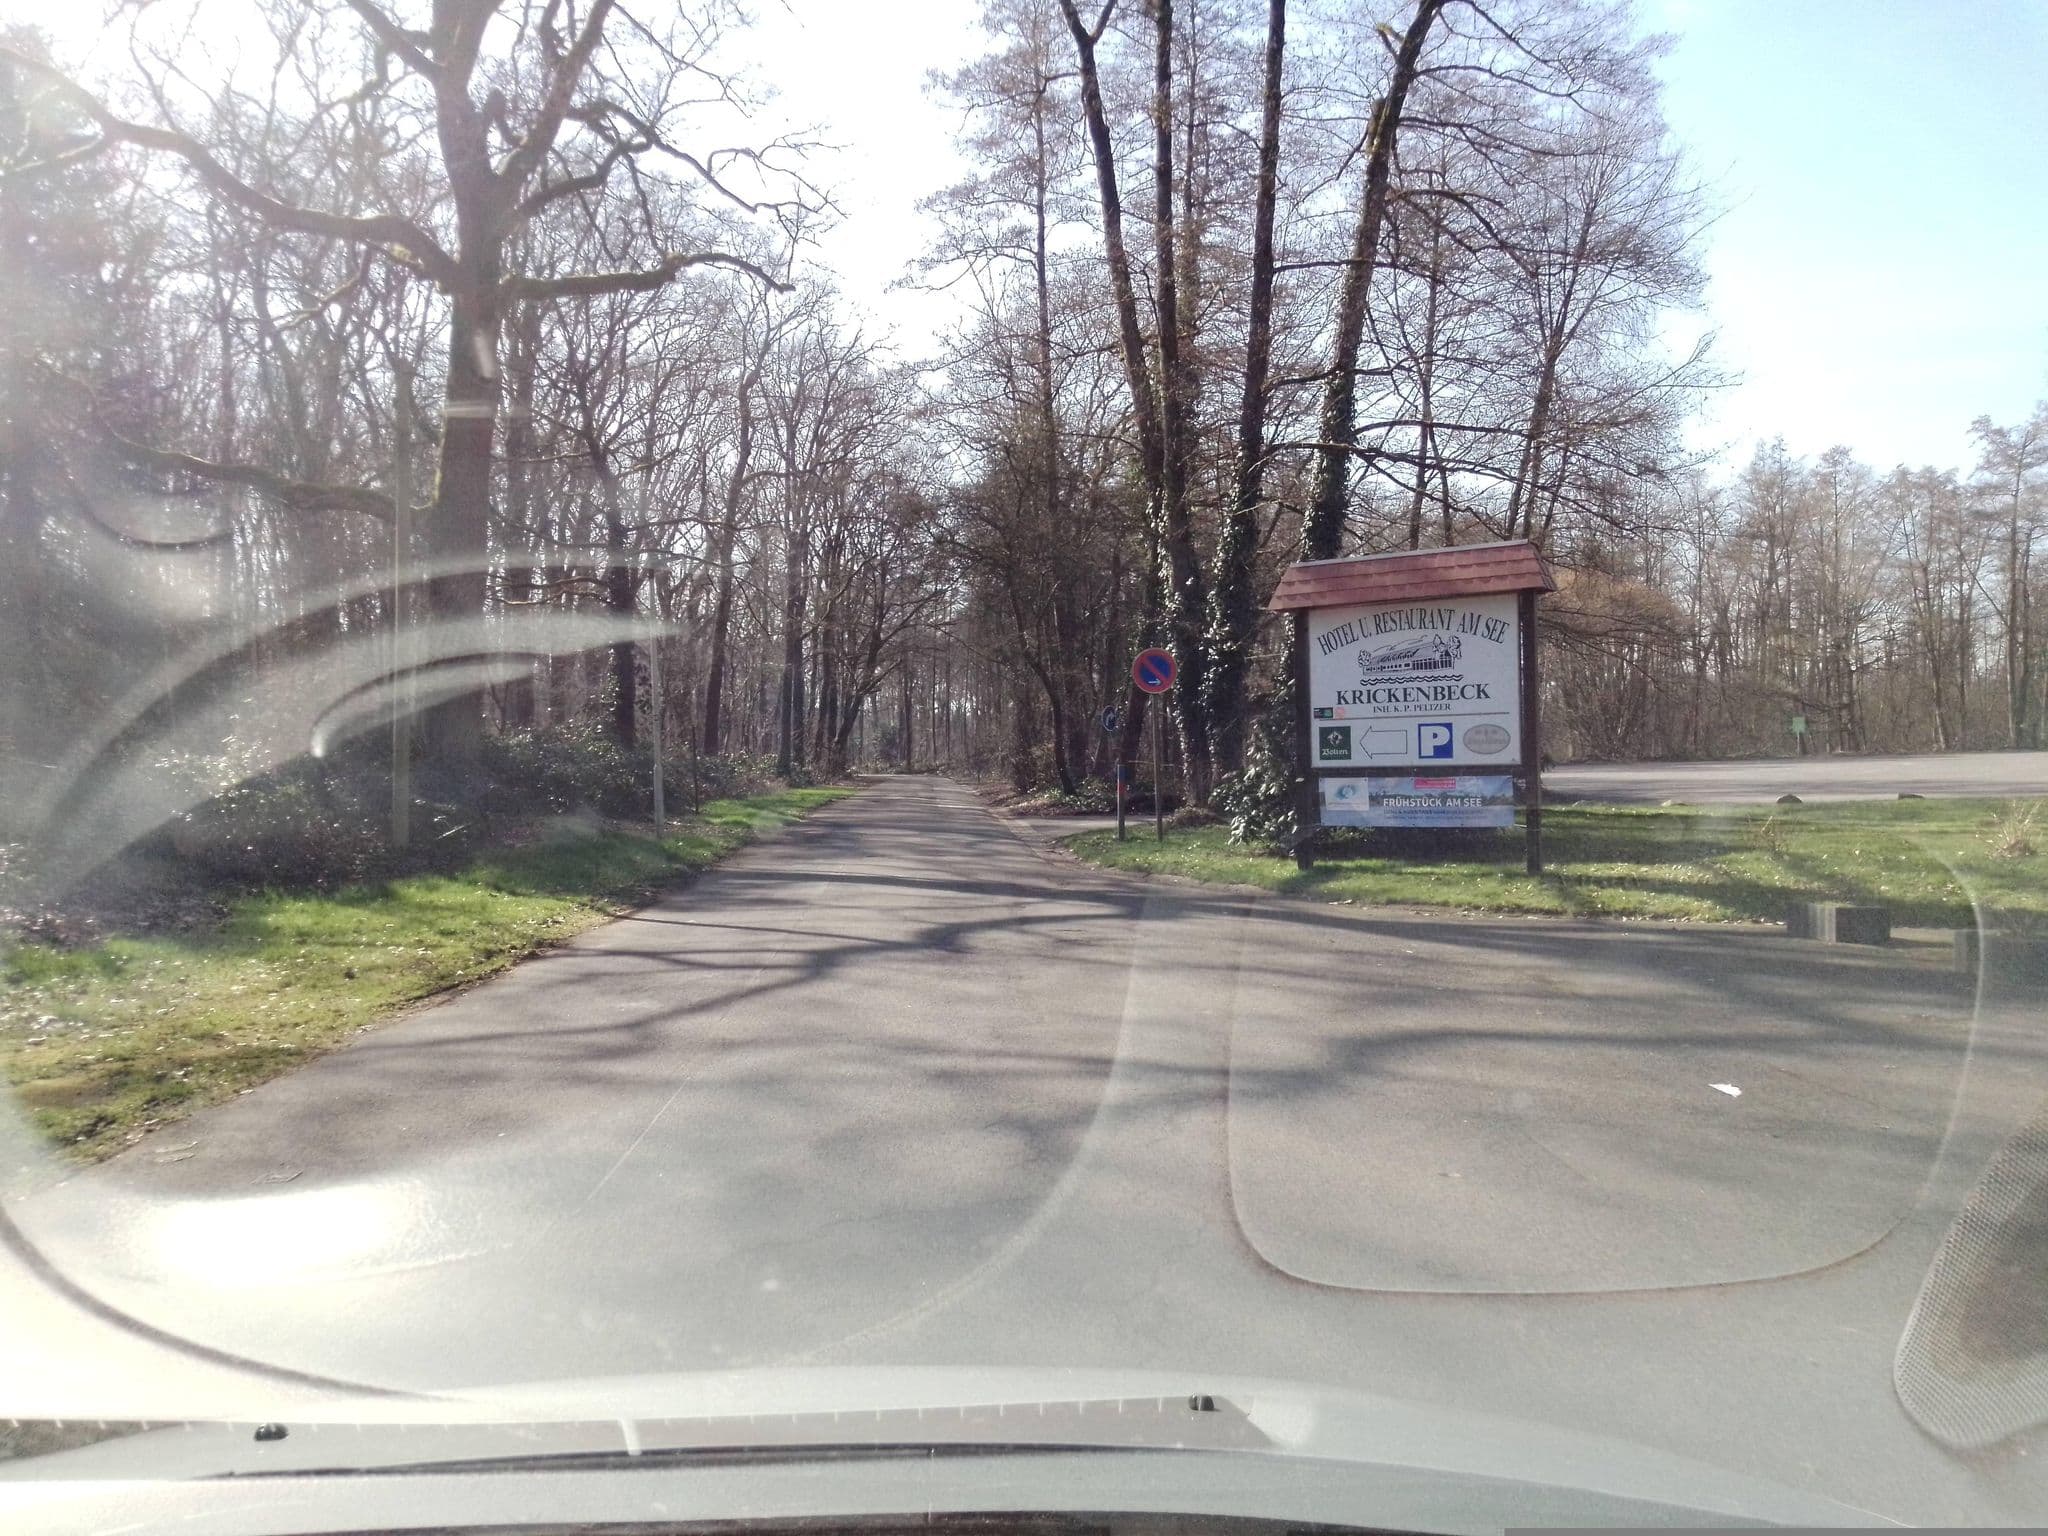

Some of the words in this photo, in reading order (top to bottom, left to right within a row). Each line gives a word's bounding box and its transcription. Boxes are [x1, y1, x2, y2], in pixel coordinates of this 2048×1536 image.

[1318, 622, 1359, 656] HOTEL
[1358, 617, 1372, 639] U.
[1373, 608, 1455, 635] RESTAURANT
[1457, 612, 1482, 635] AM
[1481, 616, 1510, 644] SEE
[1336, 683, 1491, 705] KRICKENBECK
[1420, 726, 1451, 757] P
[1383, 797, 1442, 807] FRÜHSTÜCK
[1446, 799, 1461, 807] AM
[1463, 799, 1482, 807] SEE
